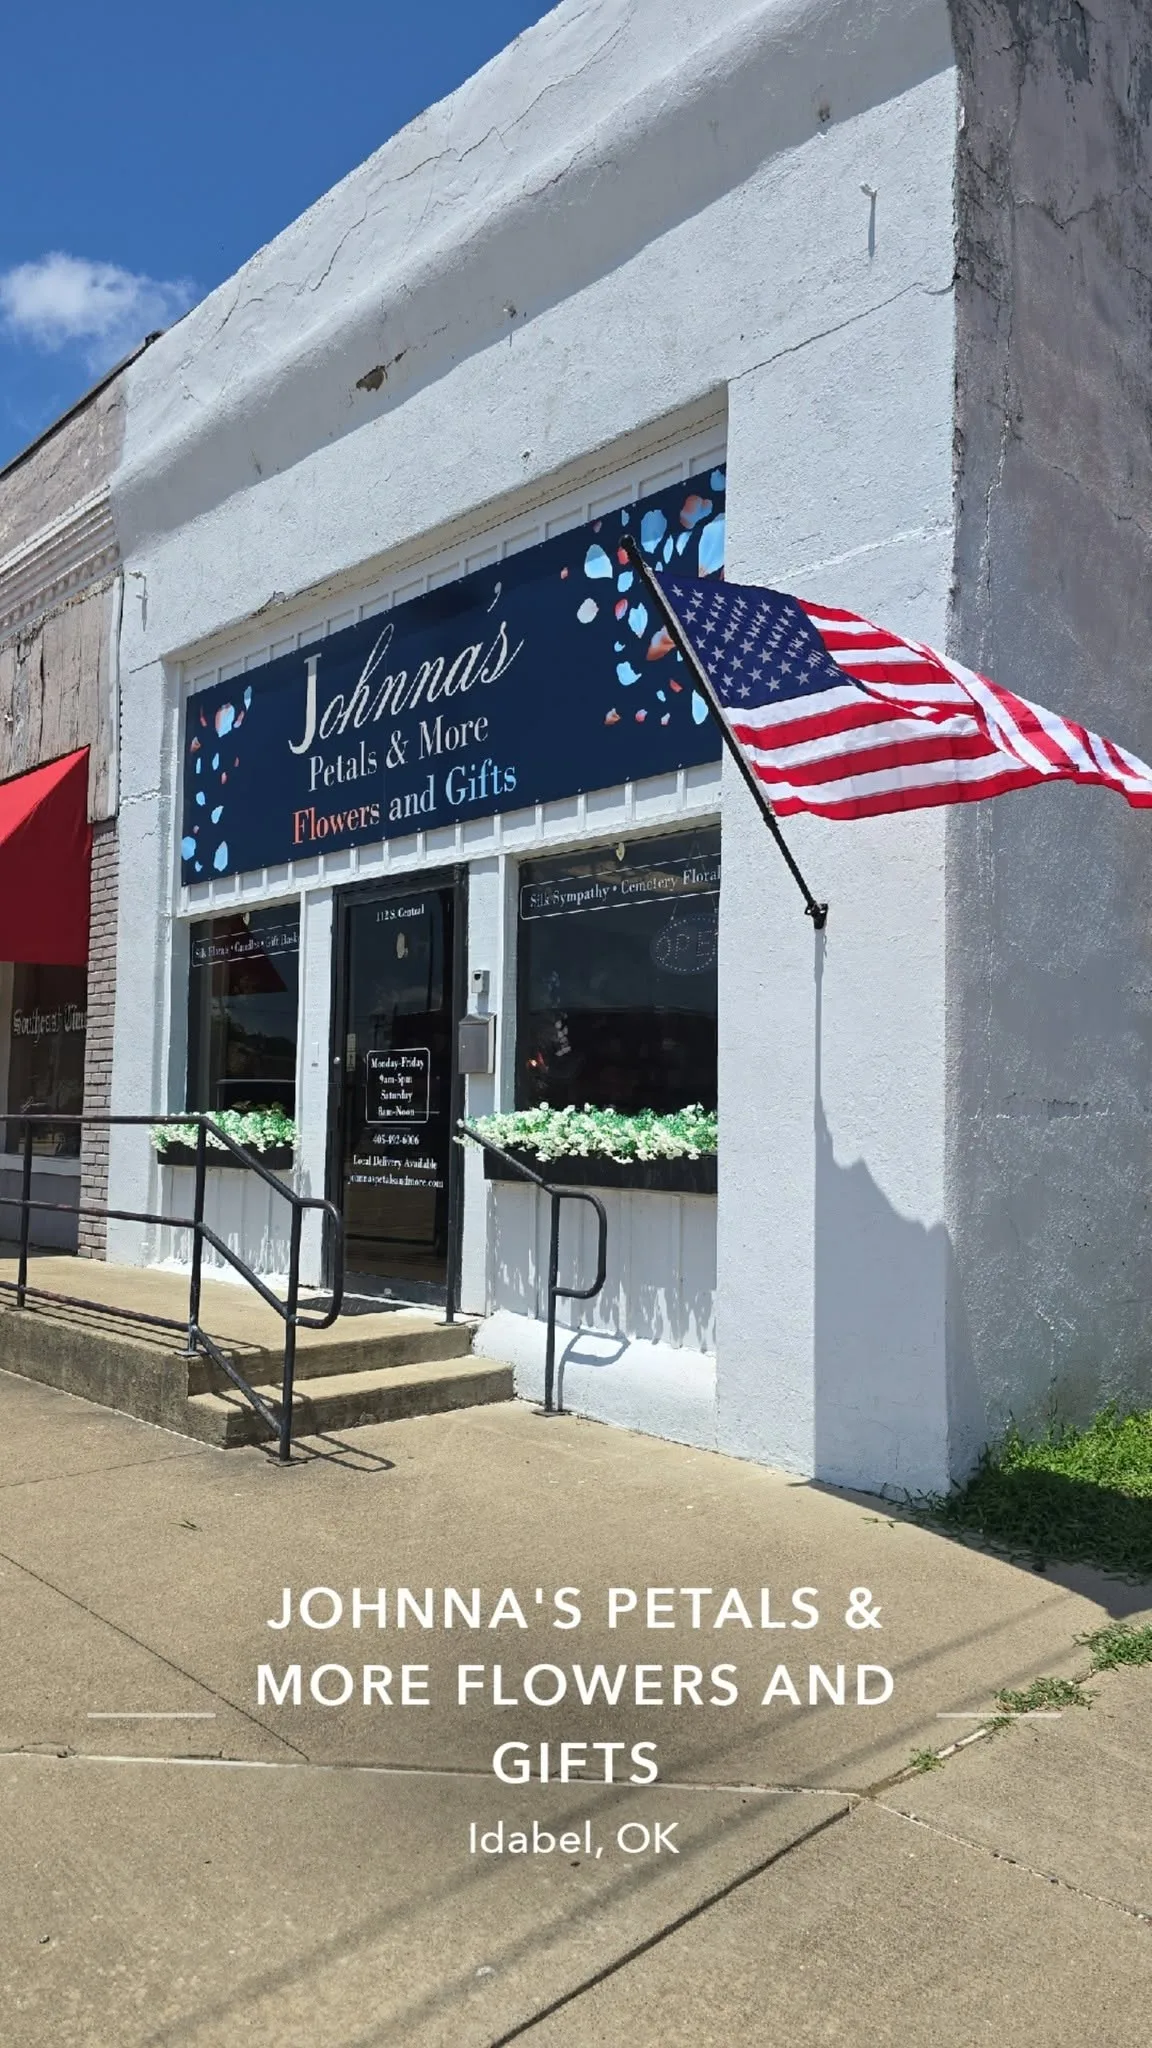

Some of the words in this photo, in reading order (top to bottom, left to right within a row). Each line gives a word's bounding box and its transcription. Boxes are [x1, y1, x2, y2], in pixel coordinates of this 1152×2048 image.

[288, 581, 525, 755] Johnna's
[308, 740, 378, 793] Petals
[385, 730, 410, 770] &
[418, 714, 489, 762] More
[291, 804, 381, 846] Flowers
[388, 774, 436, 822] and
[444, 758, 518, 808] Gifts
[530, 892, 550, 909] Silk
[551, 884, 610, 909] Sympathy
[621, 875, 678, 896] Cemetery
[397, 903, 425, 918] Central
[656, 928, 718, 959] OPE
[371, 1056, 424, 1070] Monday-Friday
[380, 1089, 413, 1103] Saturday
[353, 1154, 372, 1166] Local
[373, 1155, 402, 1171] Delivery
[404, 1157, 438, 1170] Available
